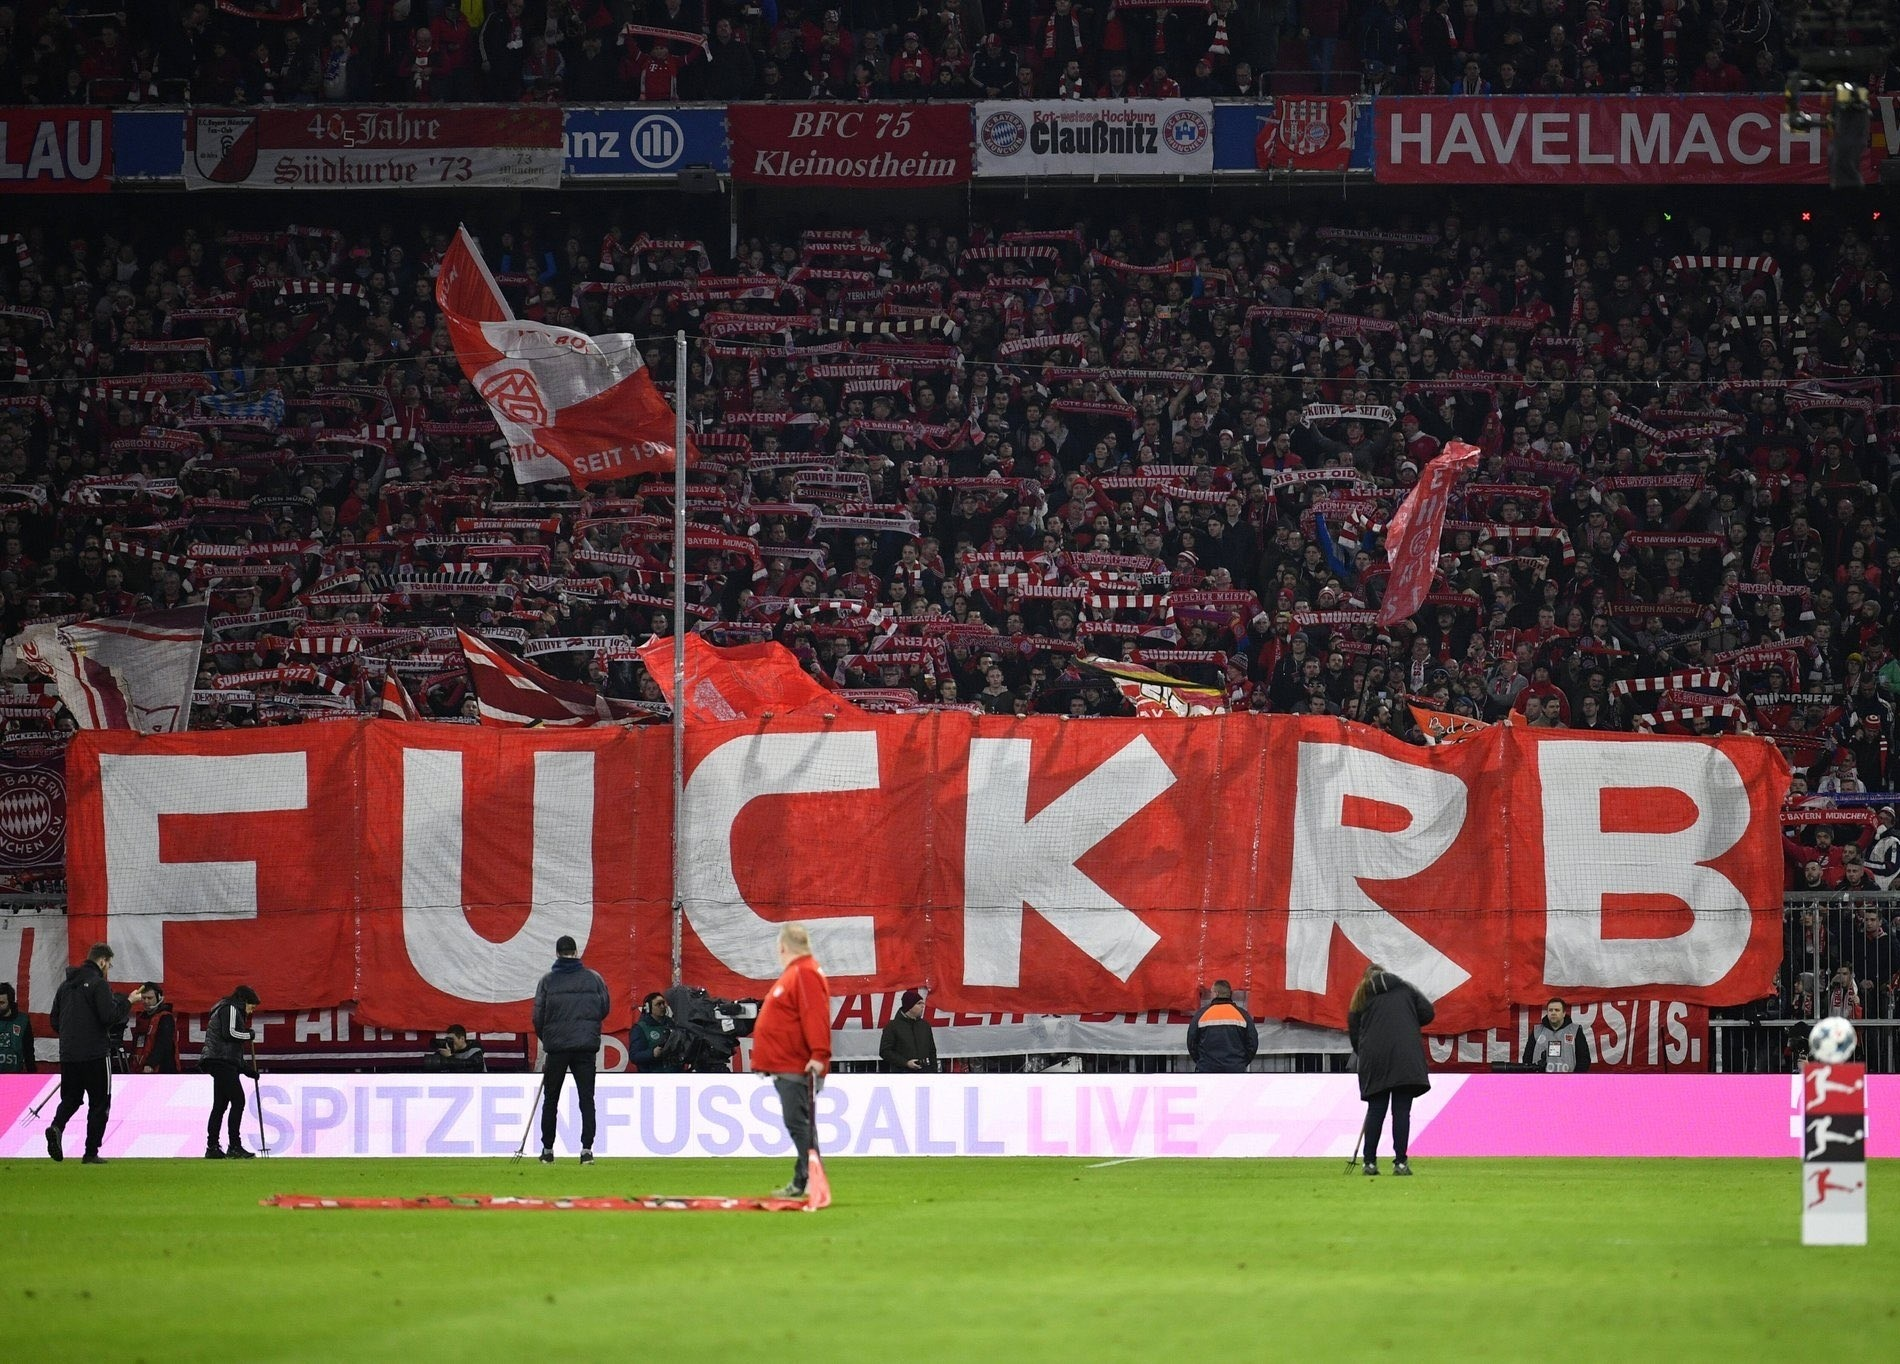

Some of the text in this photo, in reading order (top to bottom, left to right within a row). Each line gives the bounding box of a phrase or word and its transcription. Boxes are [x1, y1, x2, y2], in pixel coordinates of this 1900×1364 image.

[992, 113, 1024, 131] BAYERN
[1101, 109, 1156, 125] Hochburg
[354, 112, 440, 144] Jahre
[788, 111, 914, 139] BFC 75
[1030, 119, 1158, 155] Claußnitz
[274, 154, 474, 185] Südkurve '73
[752, 149, 957, 178] Kleinostheim
[806, 230, 852, 239] AYERN
[636, 240, 685, 249] AYERN
[834, 242, 856, 250] SAN
[680, 291, 730, 300] SAN MIA
[716, 321, 776, 334] BAYERN
[813, 360, 880, 378] SÜDKURVE
[1110, 369, 1147, 380] BAYERN
[1149, 370, 1195, 382] MÜNCHEN
[726, 412, 787, 423] BAYERN
[1358, 406, 1377, 418] SEIT
[1658, 424, 1721, 442] BAYERN
[573, 446, 624, 475] SEIT
[1142, 464, 1199, 477] SÜDKUR
[1298, 471, 1327, 481] ROT
[1659, 475, 1695, 486] MÜNCHEN
[1162, 485, 1230, 502] SÜDKURVE
[473, 520, 541, 530] BAYERN MÜNCHEN
[686, 537, 719, 547] BAYERN
[1631, 535, 1718, 545] FC BAYERN MÜNCHEN
[191, 542, 299, 556] SÜDKURV MIA
[573, 550, 644, 568] SÜDKURVE
[966, 551, 1024, 562] SAN MIA
[410, 582, 498, 592] FC BAYERN MÜNCHEN
[1017, 585, 1087, 598] SÜDKURVE
[309, 593, 391, 604] SÜDKURVE
[624, 594, 710, 614] MÜNCEN
[1614, 604, 1696, 614] FC BAYERN MÜNCHEN
[1320, 610, 1379, 624] MÜNCHE
[1085, 622, 1140, 634] SAN MIA
[586, 638, 606, 648] SEIT
[1763, 638, 1805, 650] MÜNCHEN
[1138, 650, 1216, 662] SÜDKURVE
[1758, 651, 1783, 662] MIA
[216, 667, 312, 689] SÜDKURVE 1972
[1753, 693, 1833, 706] MÜNCHEN
[5, 774, 61, 800] BAYERN
[1788, 811, 1869, 821] BAYERN MÜNCHEN
[98, 731, 1752, 1002] FUCK RB
[246, 1084, 1199, 1156] SPITZENFUSSBALL LIVE
